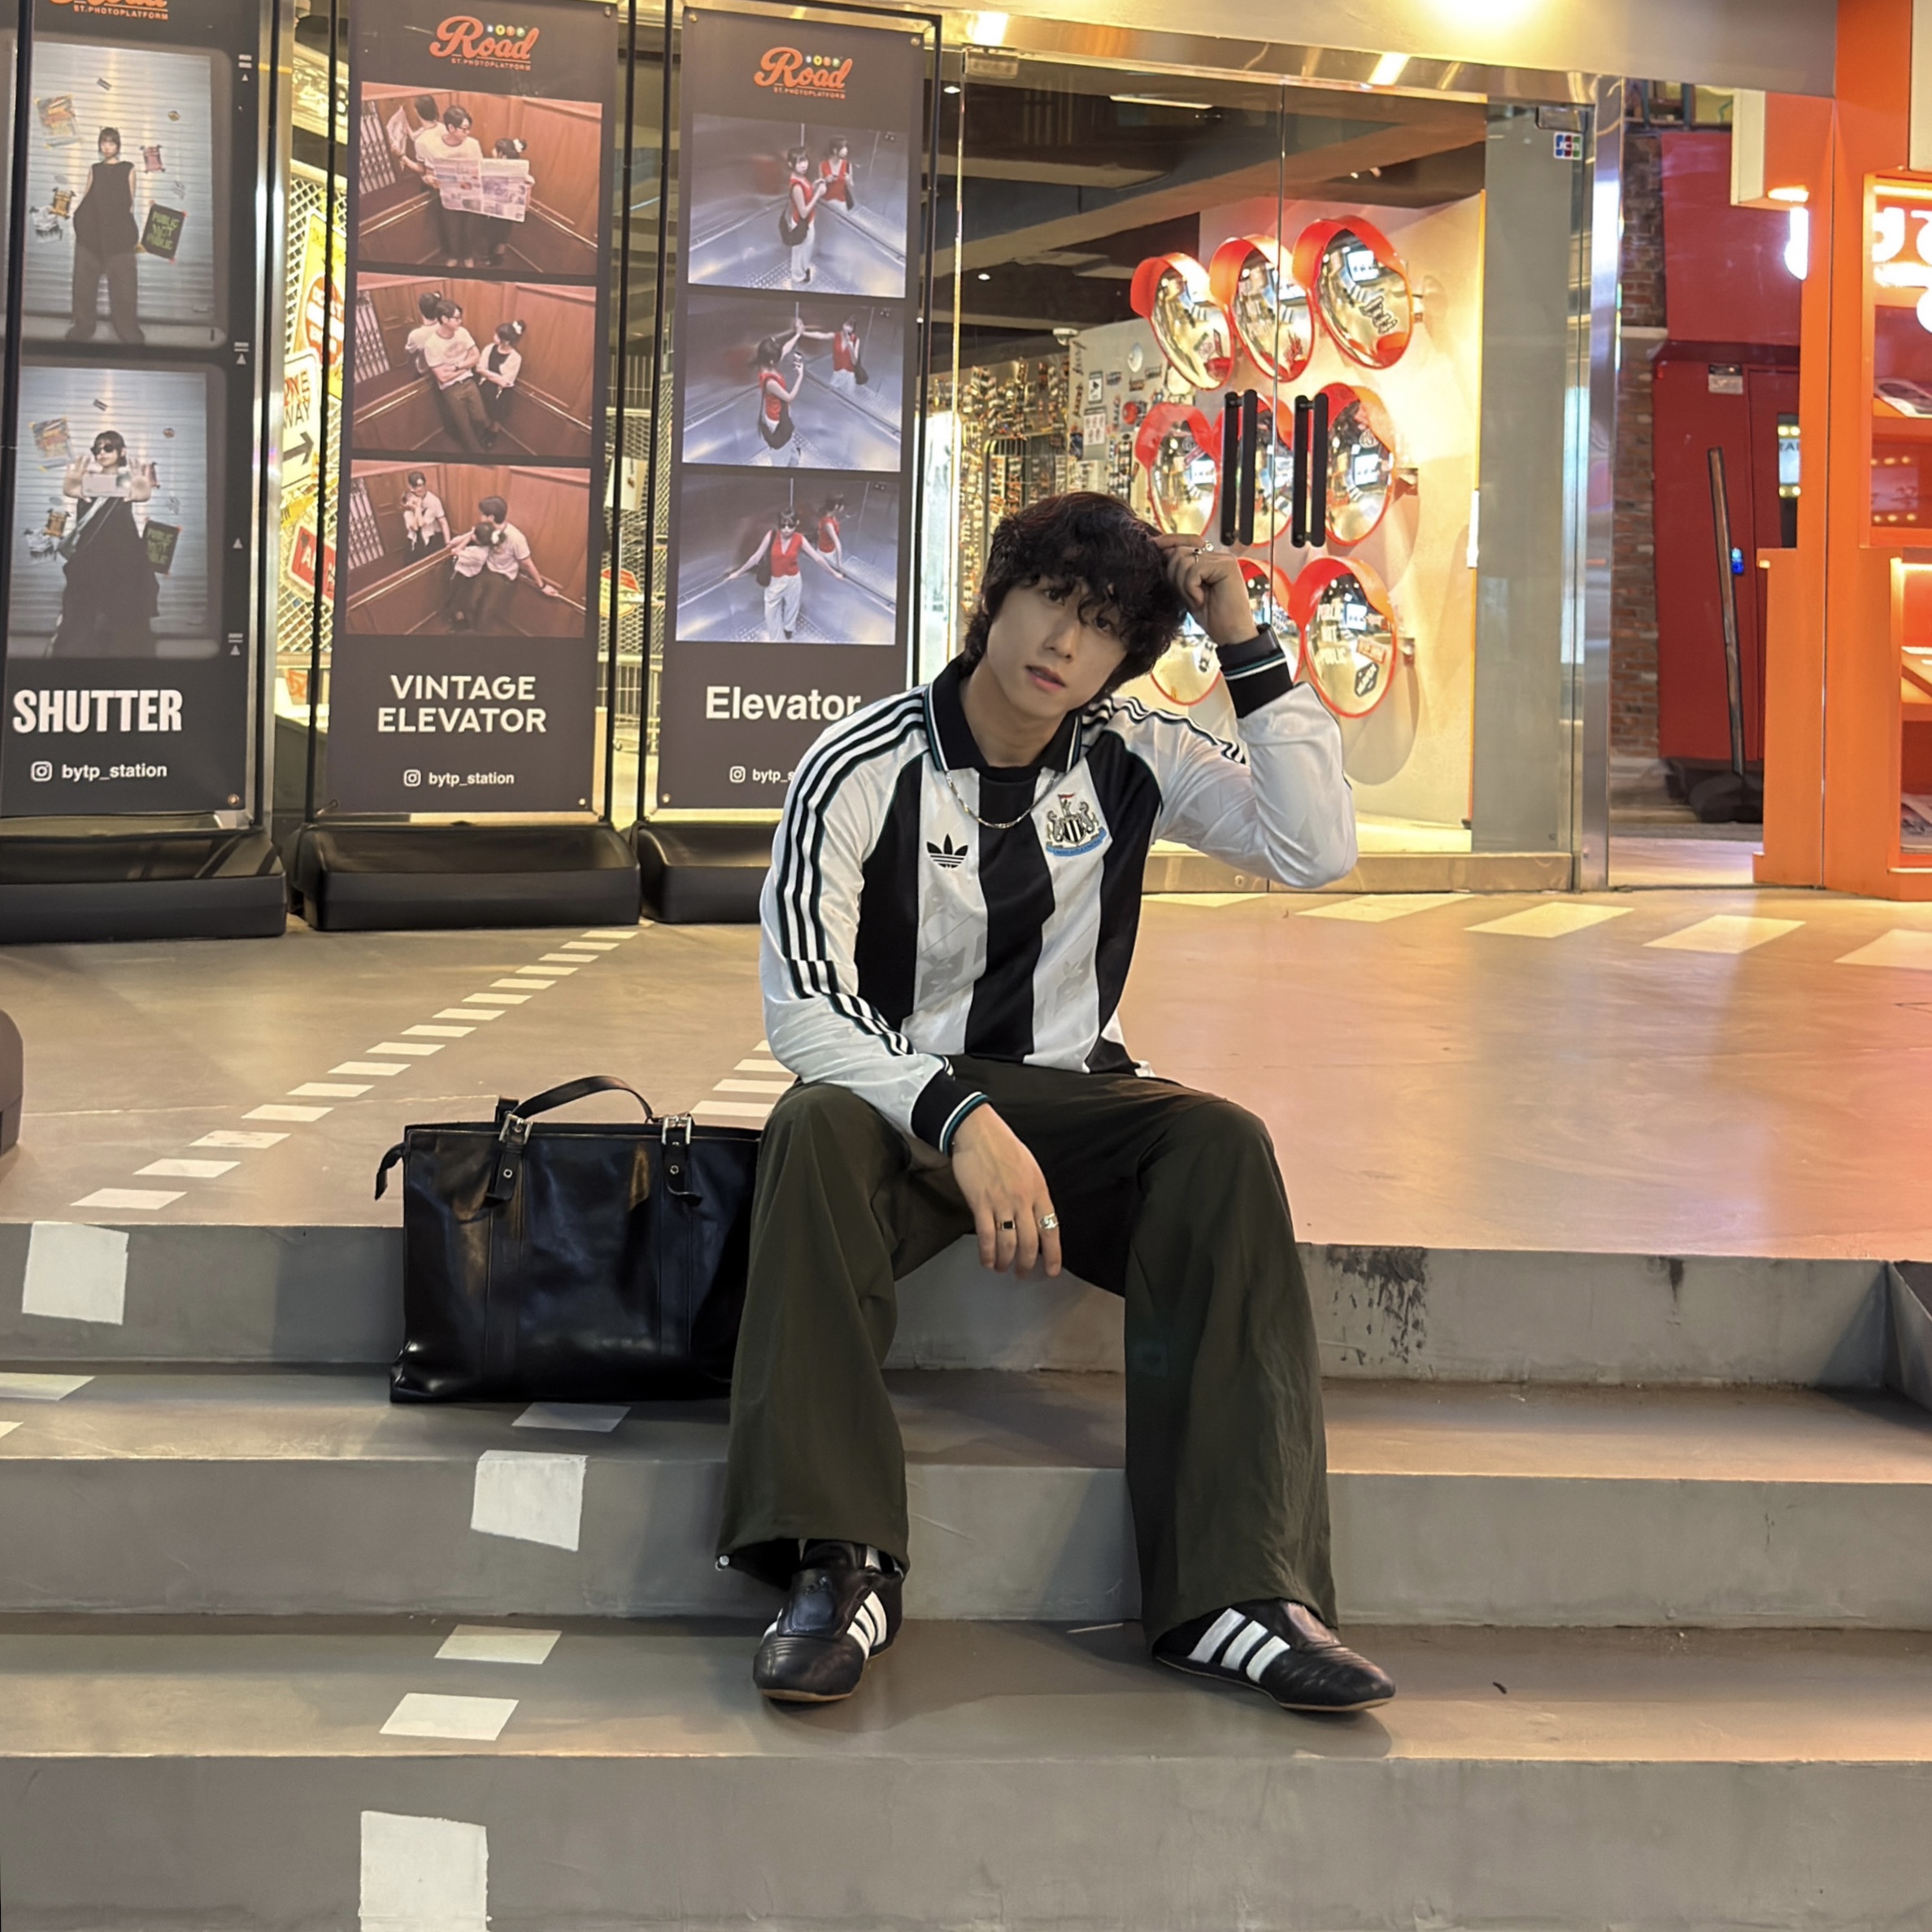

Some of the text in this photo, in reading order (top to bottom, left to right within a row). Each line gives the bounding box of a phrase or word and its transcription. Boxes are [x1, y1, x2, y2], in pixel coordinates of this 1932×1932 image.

[429, 15, 539, 59] Road
[754, 46, 853, 89] Road
[390, 675, 537, 701] VINTAGE
[12, 689, 183, 733] SHUTTER
[706, 686, 862, 720] Elevator
[378, 707, 546, 733] ELEVATOR
[62, 763, 168, 782] bytp_station
[429, 772, 515, 788] bytp_station
[752, 768, 795, 784] bytp_s
